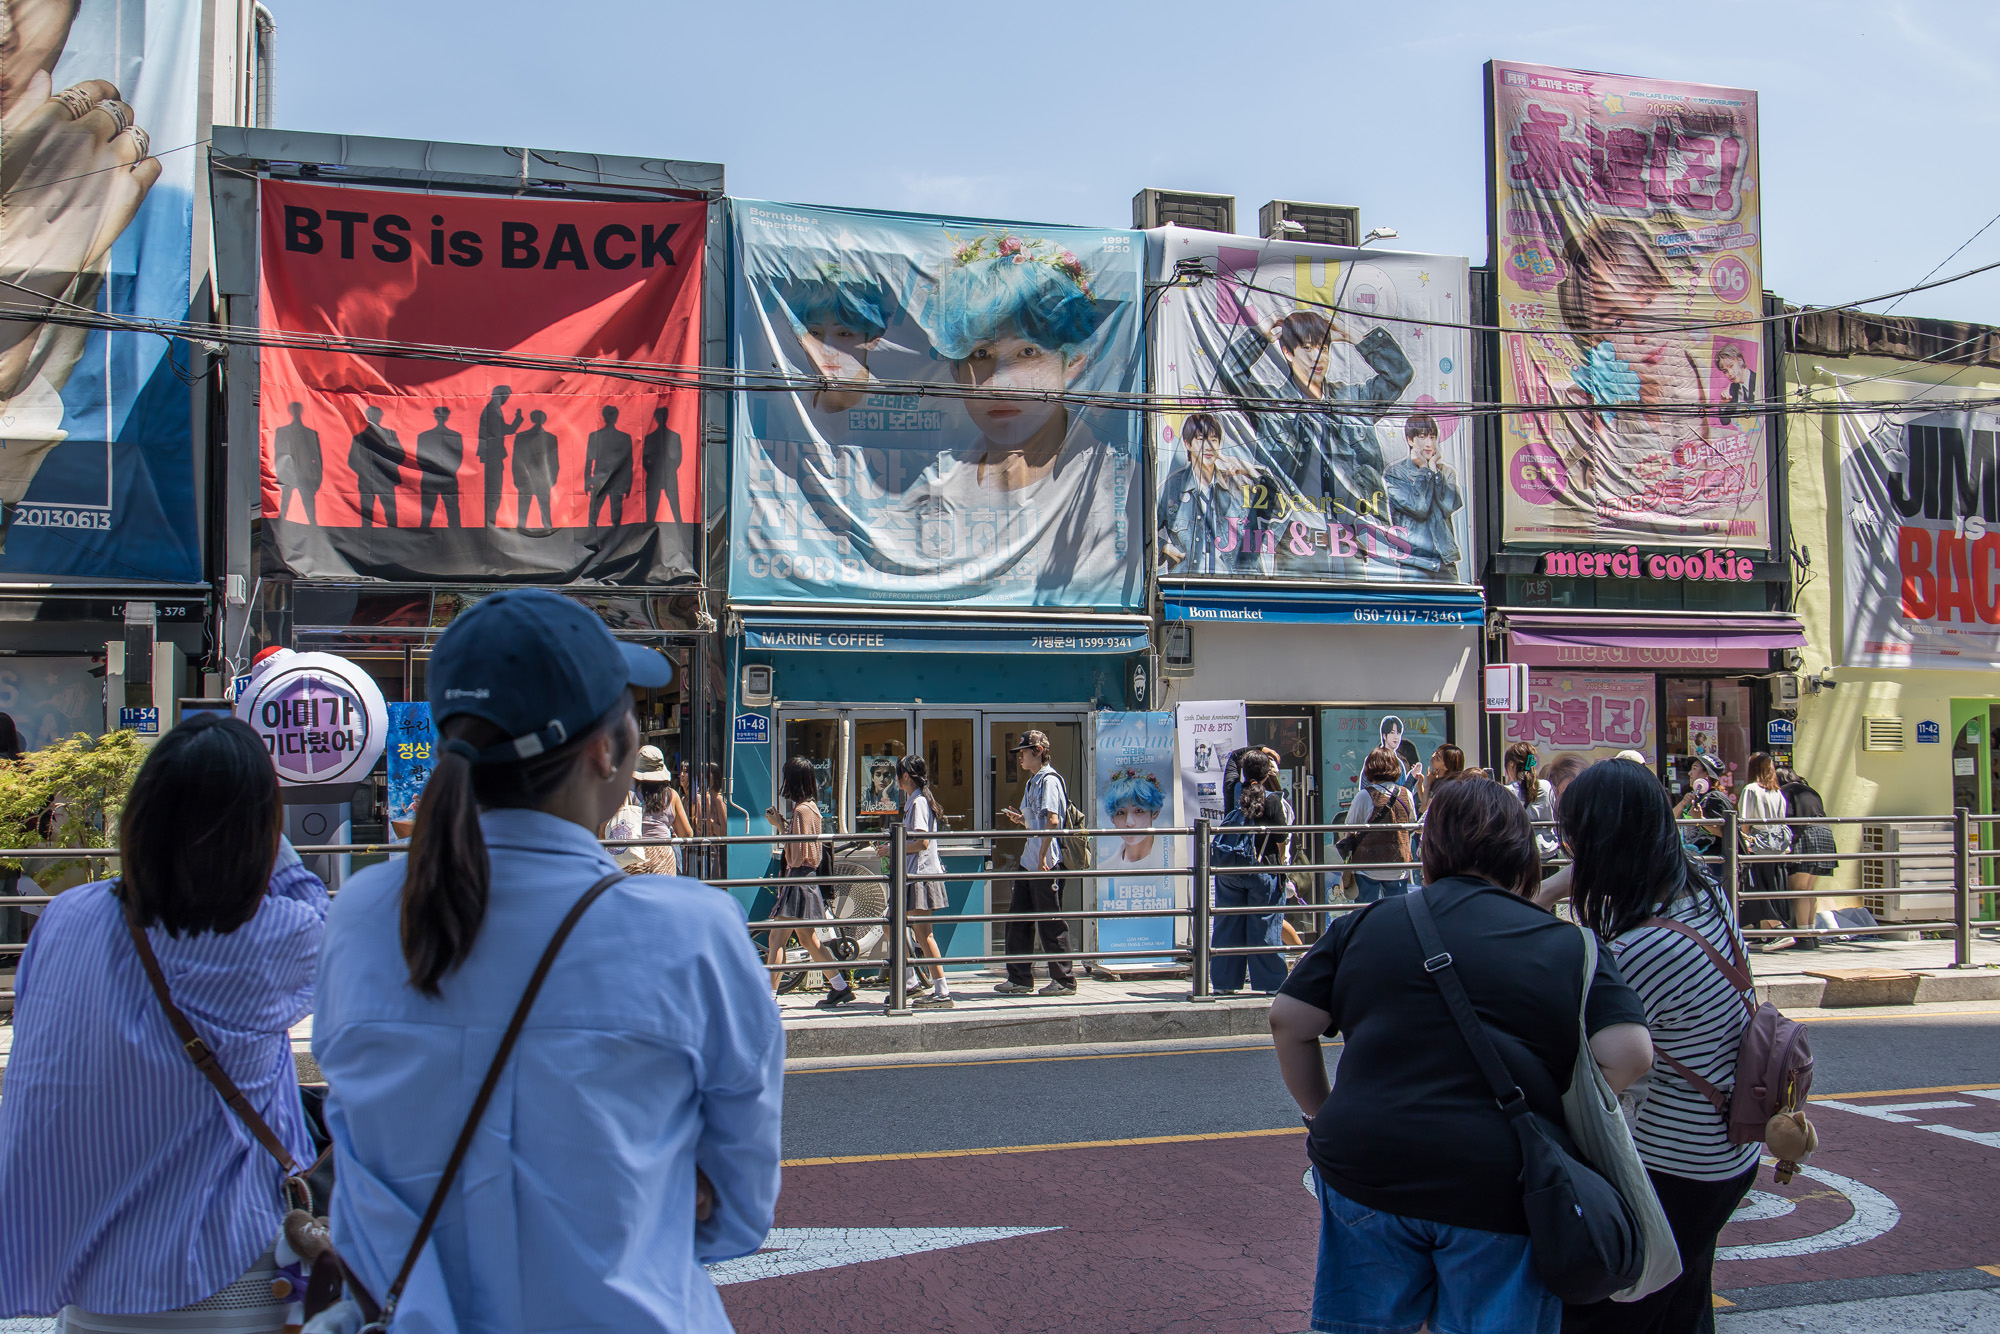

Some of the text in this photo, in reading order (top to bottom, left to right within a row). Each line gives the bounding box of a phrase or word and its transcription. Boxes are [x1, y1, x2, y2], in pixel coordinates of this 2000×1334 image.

[749, 207, 778, 219] Born
[780, 213, 792, 221] to
[794, 213, 809, 223] be
[750, 216, 811, 232] Superstar
[284, 205, 682, 271] BTS is BACK
[1102, 236, 1130, 244] 1995
[1719, 224, 1742, 238] EVER
[1102, 245, 1130, 253] 1230
[1716, 266, 1745, 291] 06
[1510, 304, 1545, 319] キラキラ
[850, 411, 941, 430] 많이 보라해
[748, 439, 907, 500] 태형아
[1242, 484, 1384, 518] 12 years of
[14, 508, 111, 529] 20130613
[748, 497, 851, 555] 전역
[1725, 520, 1757, 537] JIMIN
[1954, 515, 1987, 541] IS
[1114, 519, 1128, 561] BACK
[1214, 516, 1413, 561] Jin & BTS
[748, 553, 835, 581] GOOD
[842, 557, 908, 586] BYE!
[1544, 545, 1754, 581] merci cookie
[868, 591, 887, 599] LOVE
[911, 592, 942, 600] CHINESE
[164, 606, 186, 616] 378
[1189, 606, 1463, 624] Bom market 050-7017-73461
[761, 631, 1132, 649] MARINE COFFEE 가맹문의 1599-9341
[123, 708, 156, 720] 11-54
[262, 696, 354, 729] 아미가
[1211, 714, 1240, 722] Anniversary
[399, 717, 430, 735] 우리
[737, 718, 765, 730] 11-48
[1192, 722, 1233, 734] JIN & BTS
[1338, 717, 1368, 731] BTS
[1770, 723, 1792, 734] 11-44
[1918, 724, 1938, 734] 11-42
[262, 729, 355, 756] 기다렸어
[397, 741, 431, 760] 정상
[1119, 884, 1157, 899] 태형아
